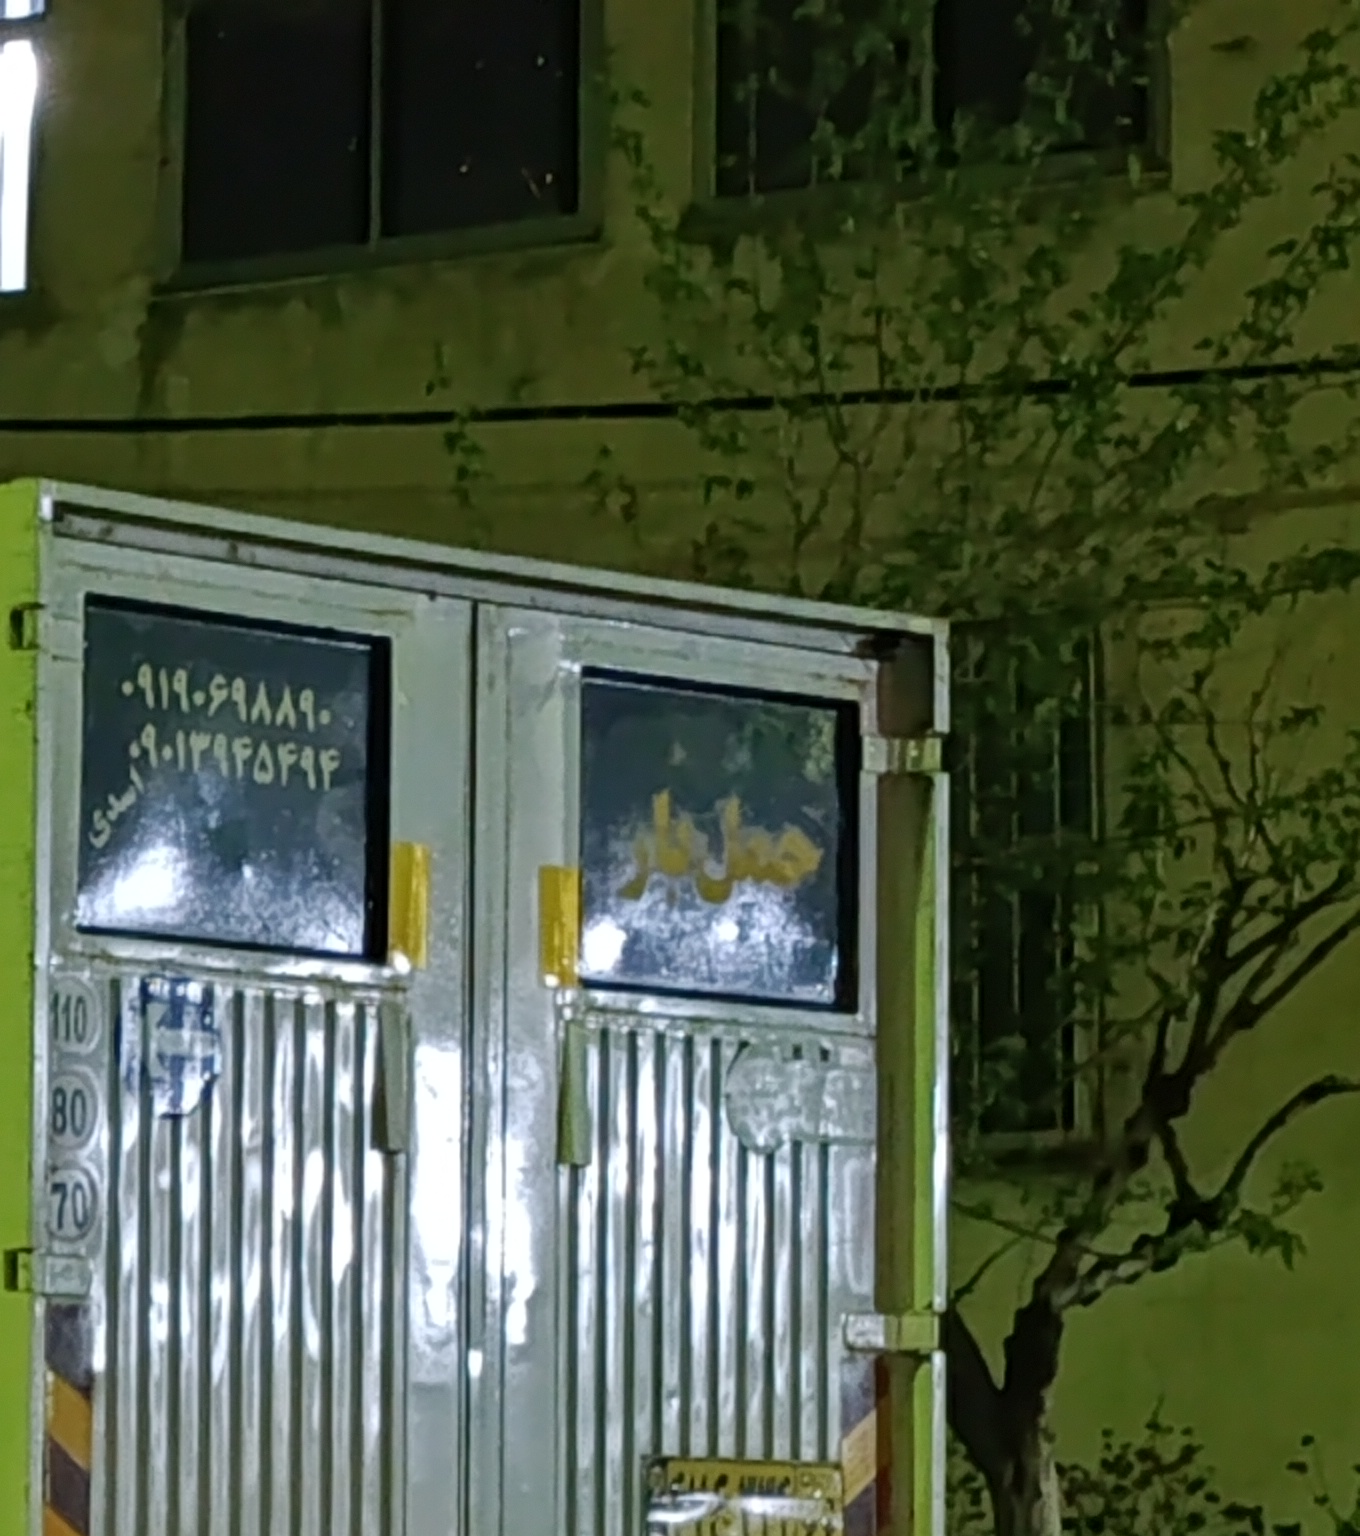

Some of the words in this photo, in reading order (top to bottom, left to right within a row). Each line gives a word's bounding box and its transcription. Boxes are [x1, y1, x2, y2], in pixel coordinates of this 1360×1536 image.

[122, 663, 331, 733] ۰۹۱۹۰۶۹۸۸۹۰
[88, 764, 145, 849] اسدی
[51, 991, 89, 1044] 110
[51, 1086, 88, 1138] 80
[50, 1182, 89, 1232] 70
